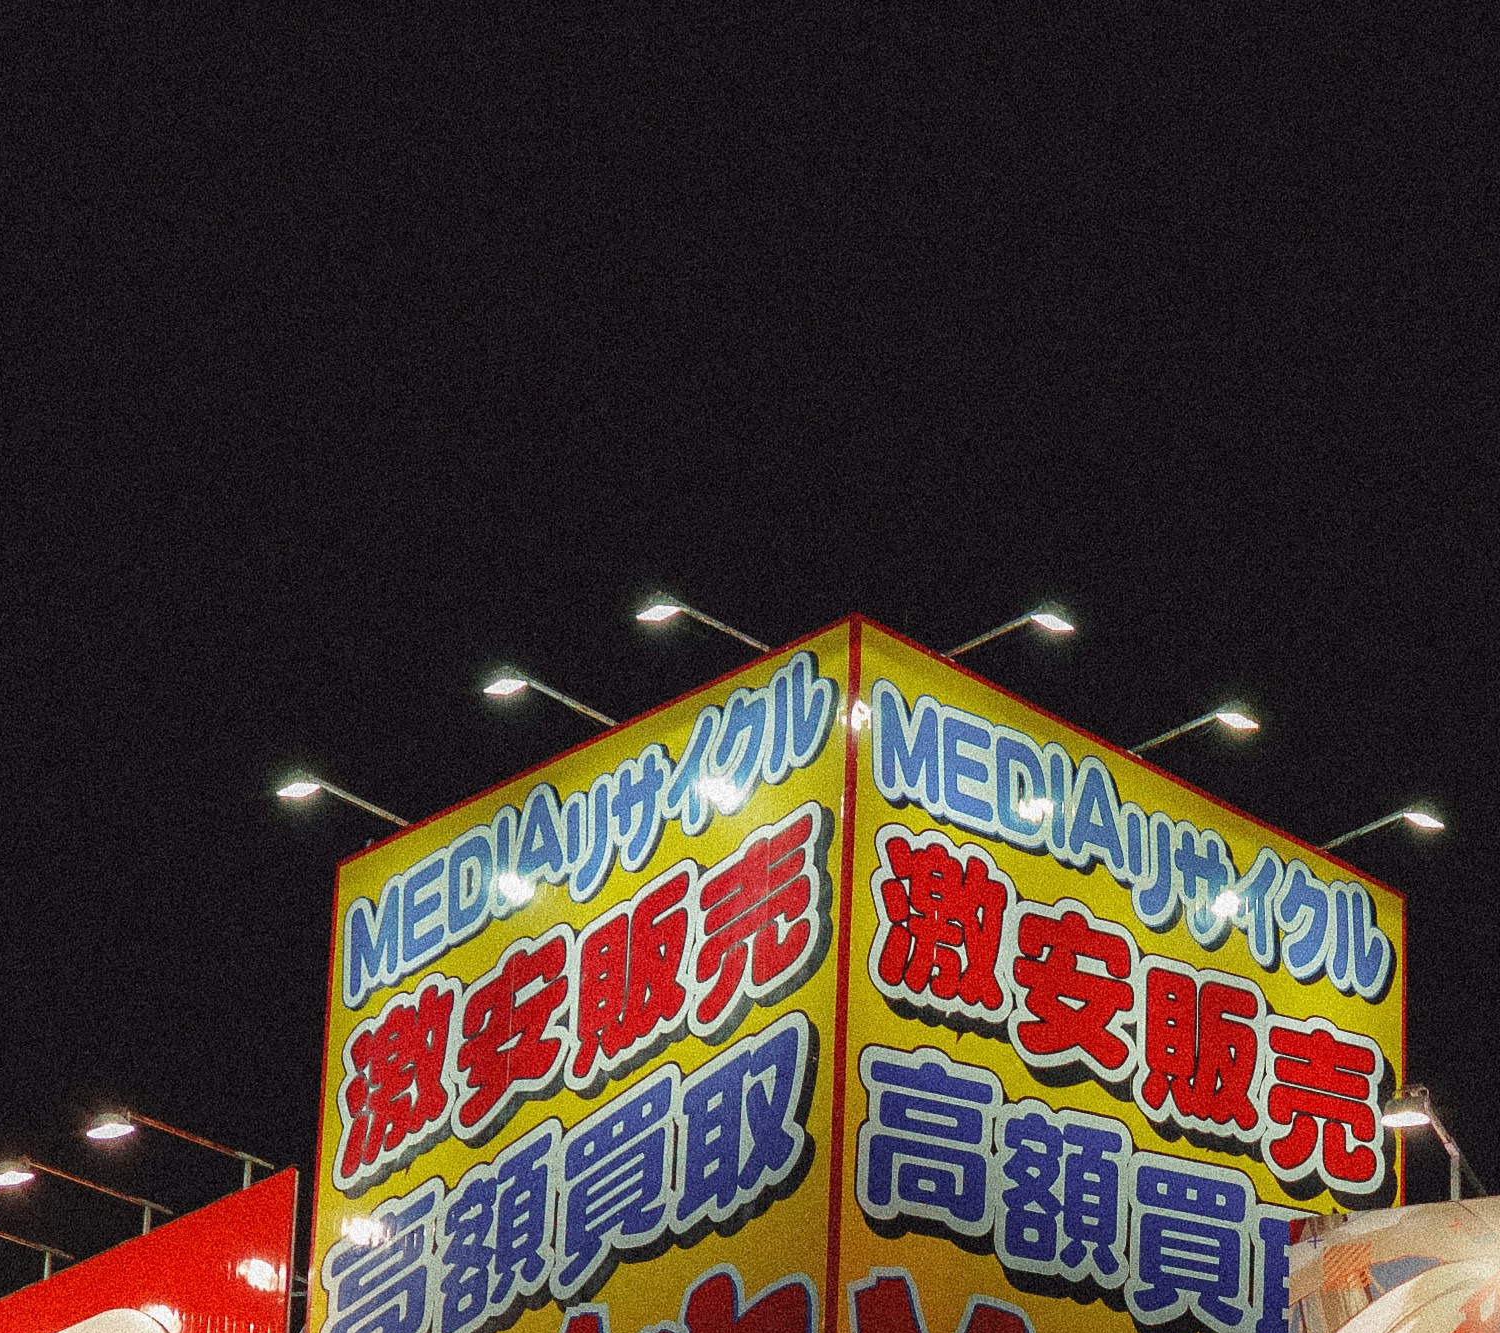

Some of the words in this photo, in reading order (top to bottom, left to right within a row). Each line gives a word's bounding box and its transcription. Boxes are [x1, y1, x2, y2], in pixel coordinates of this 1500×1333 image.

[334, 802, 822, 1189] 激安販売
[342, 649, 839, 1008] MEDIAリサイクル
[871, 680, 1392, 998] MEDIAリサイクル
[873, 825, 1386, 1192] 激安販売
